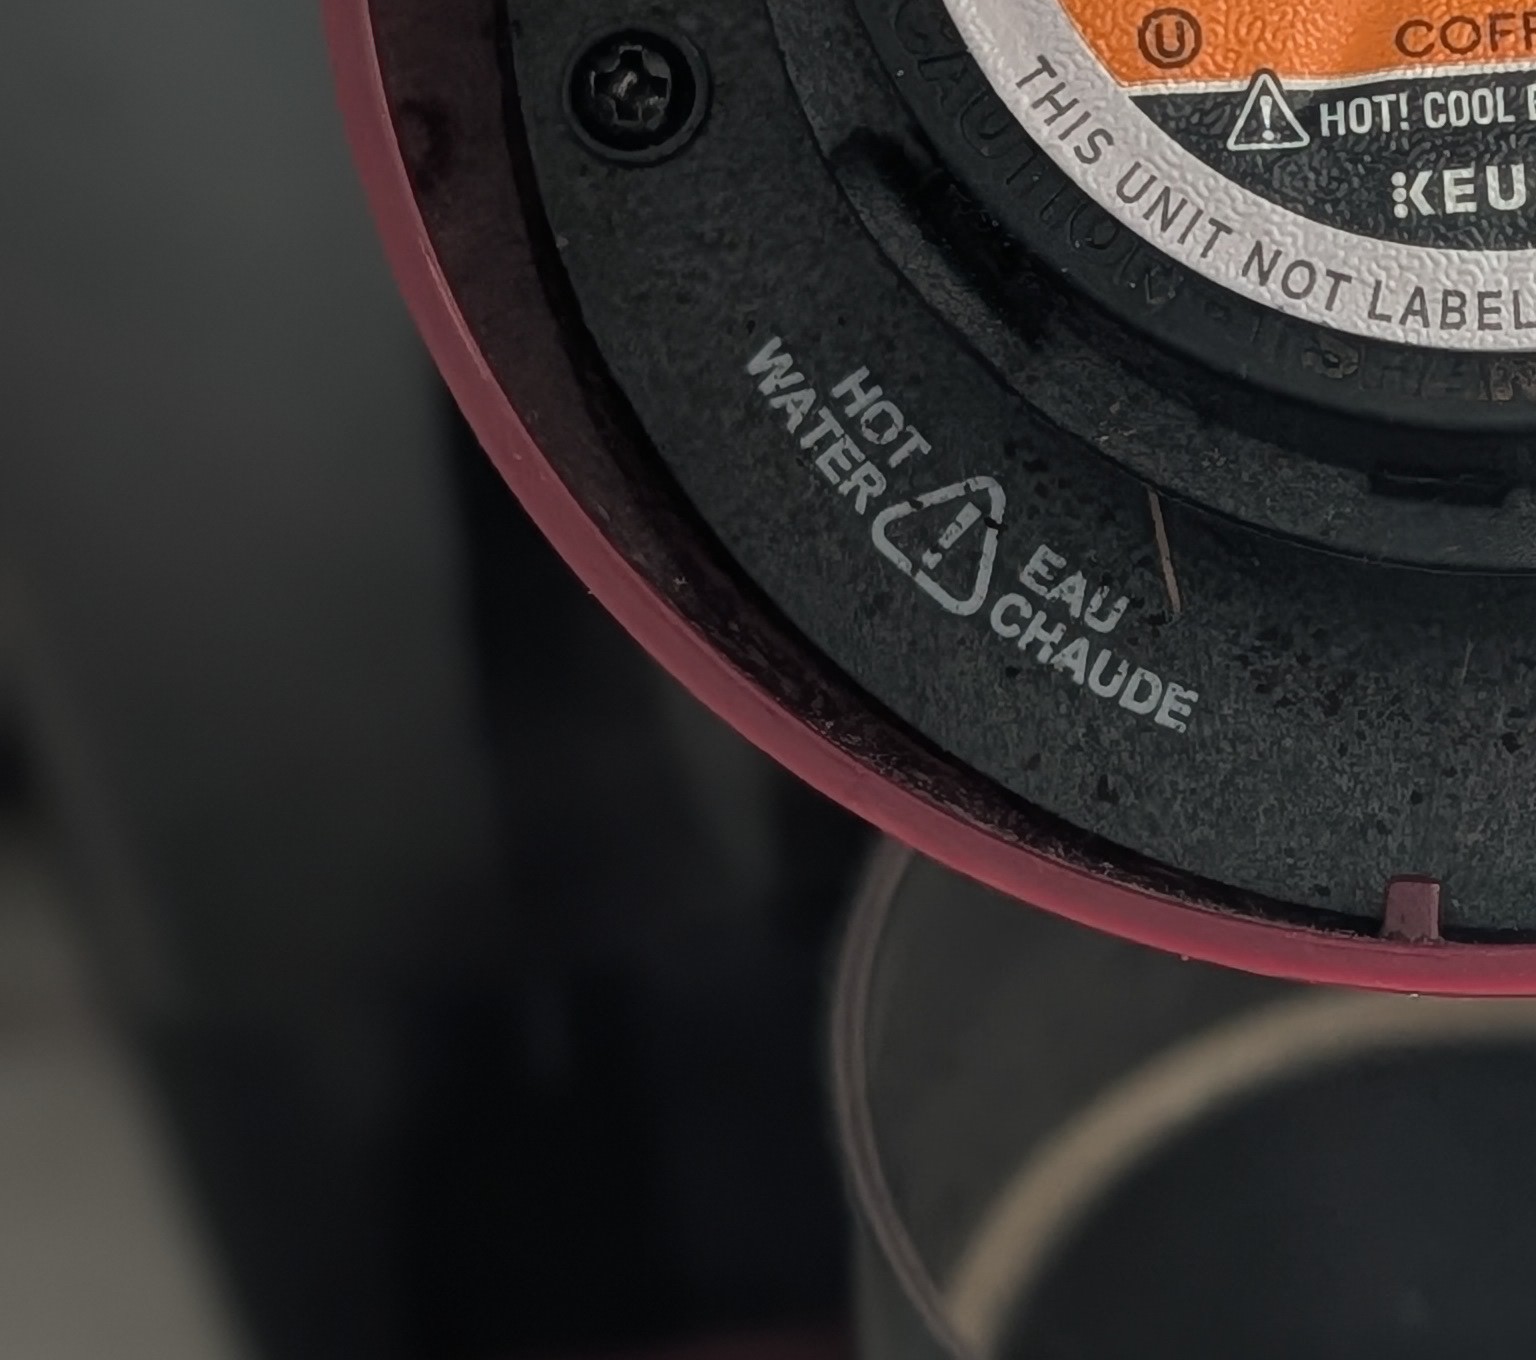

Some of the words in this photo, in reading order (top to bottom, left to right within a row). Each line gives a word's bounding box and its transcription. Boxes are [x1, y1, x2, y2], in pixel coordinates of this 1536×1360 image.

[1320, 90, 1410, 137] HOT!
[1423, 84, 1511, 130] COOL
[1015, 54, 1114, 164] THIS
[1116, 161, 1233, 259] UNIT
[1242, 239, 1353, 312] NOT
[746, 336, 887, 515] WATER
[831, 365, 932, 468] HOT
[1019, 543, 1130, 634] EAU
[990, 592, 1200, 734] CHAUDE
